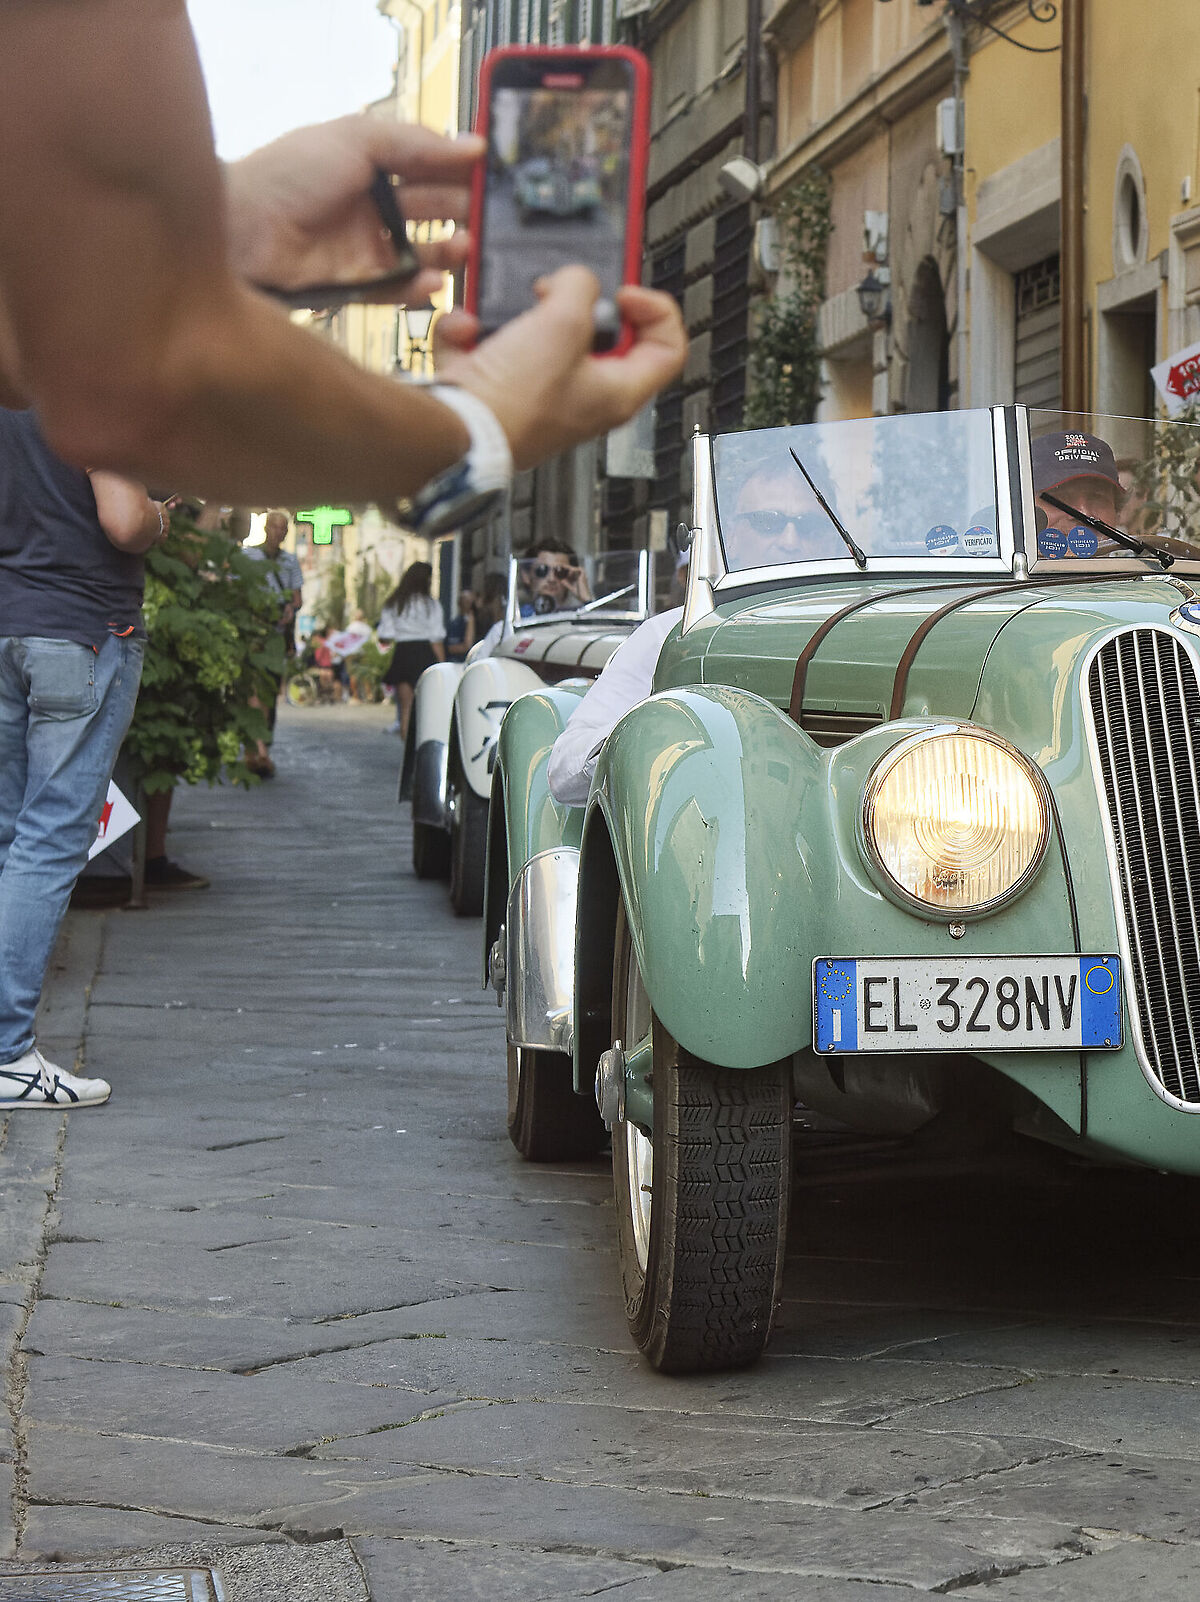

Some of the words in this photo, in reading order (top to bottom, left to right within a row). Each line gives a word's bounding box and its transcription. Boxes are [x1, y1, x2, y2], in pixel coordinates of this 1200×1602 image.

[964, 537, 993, 547] VERIFICATO
[863, 976, 918, 1033] EL
[936, 974, 1078, 1033] 328NV
